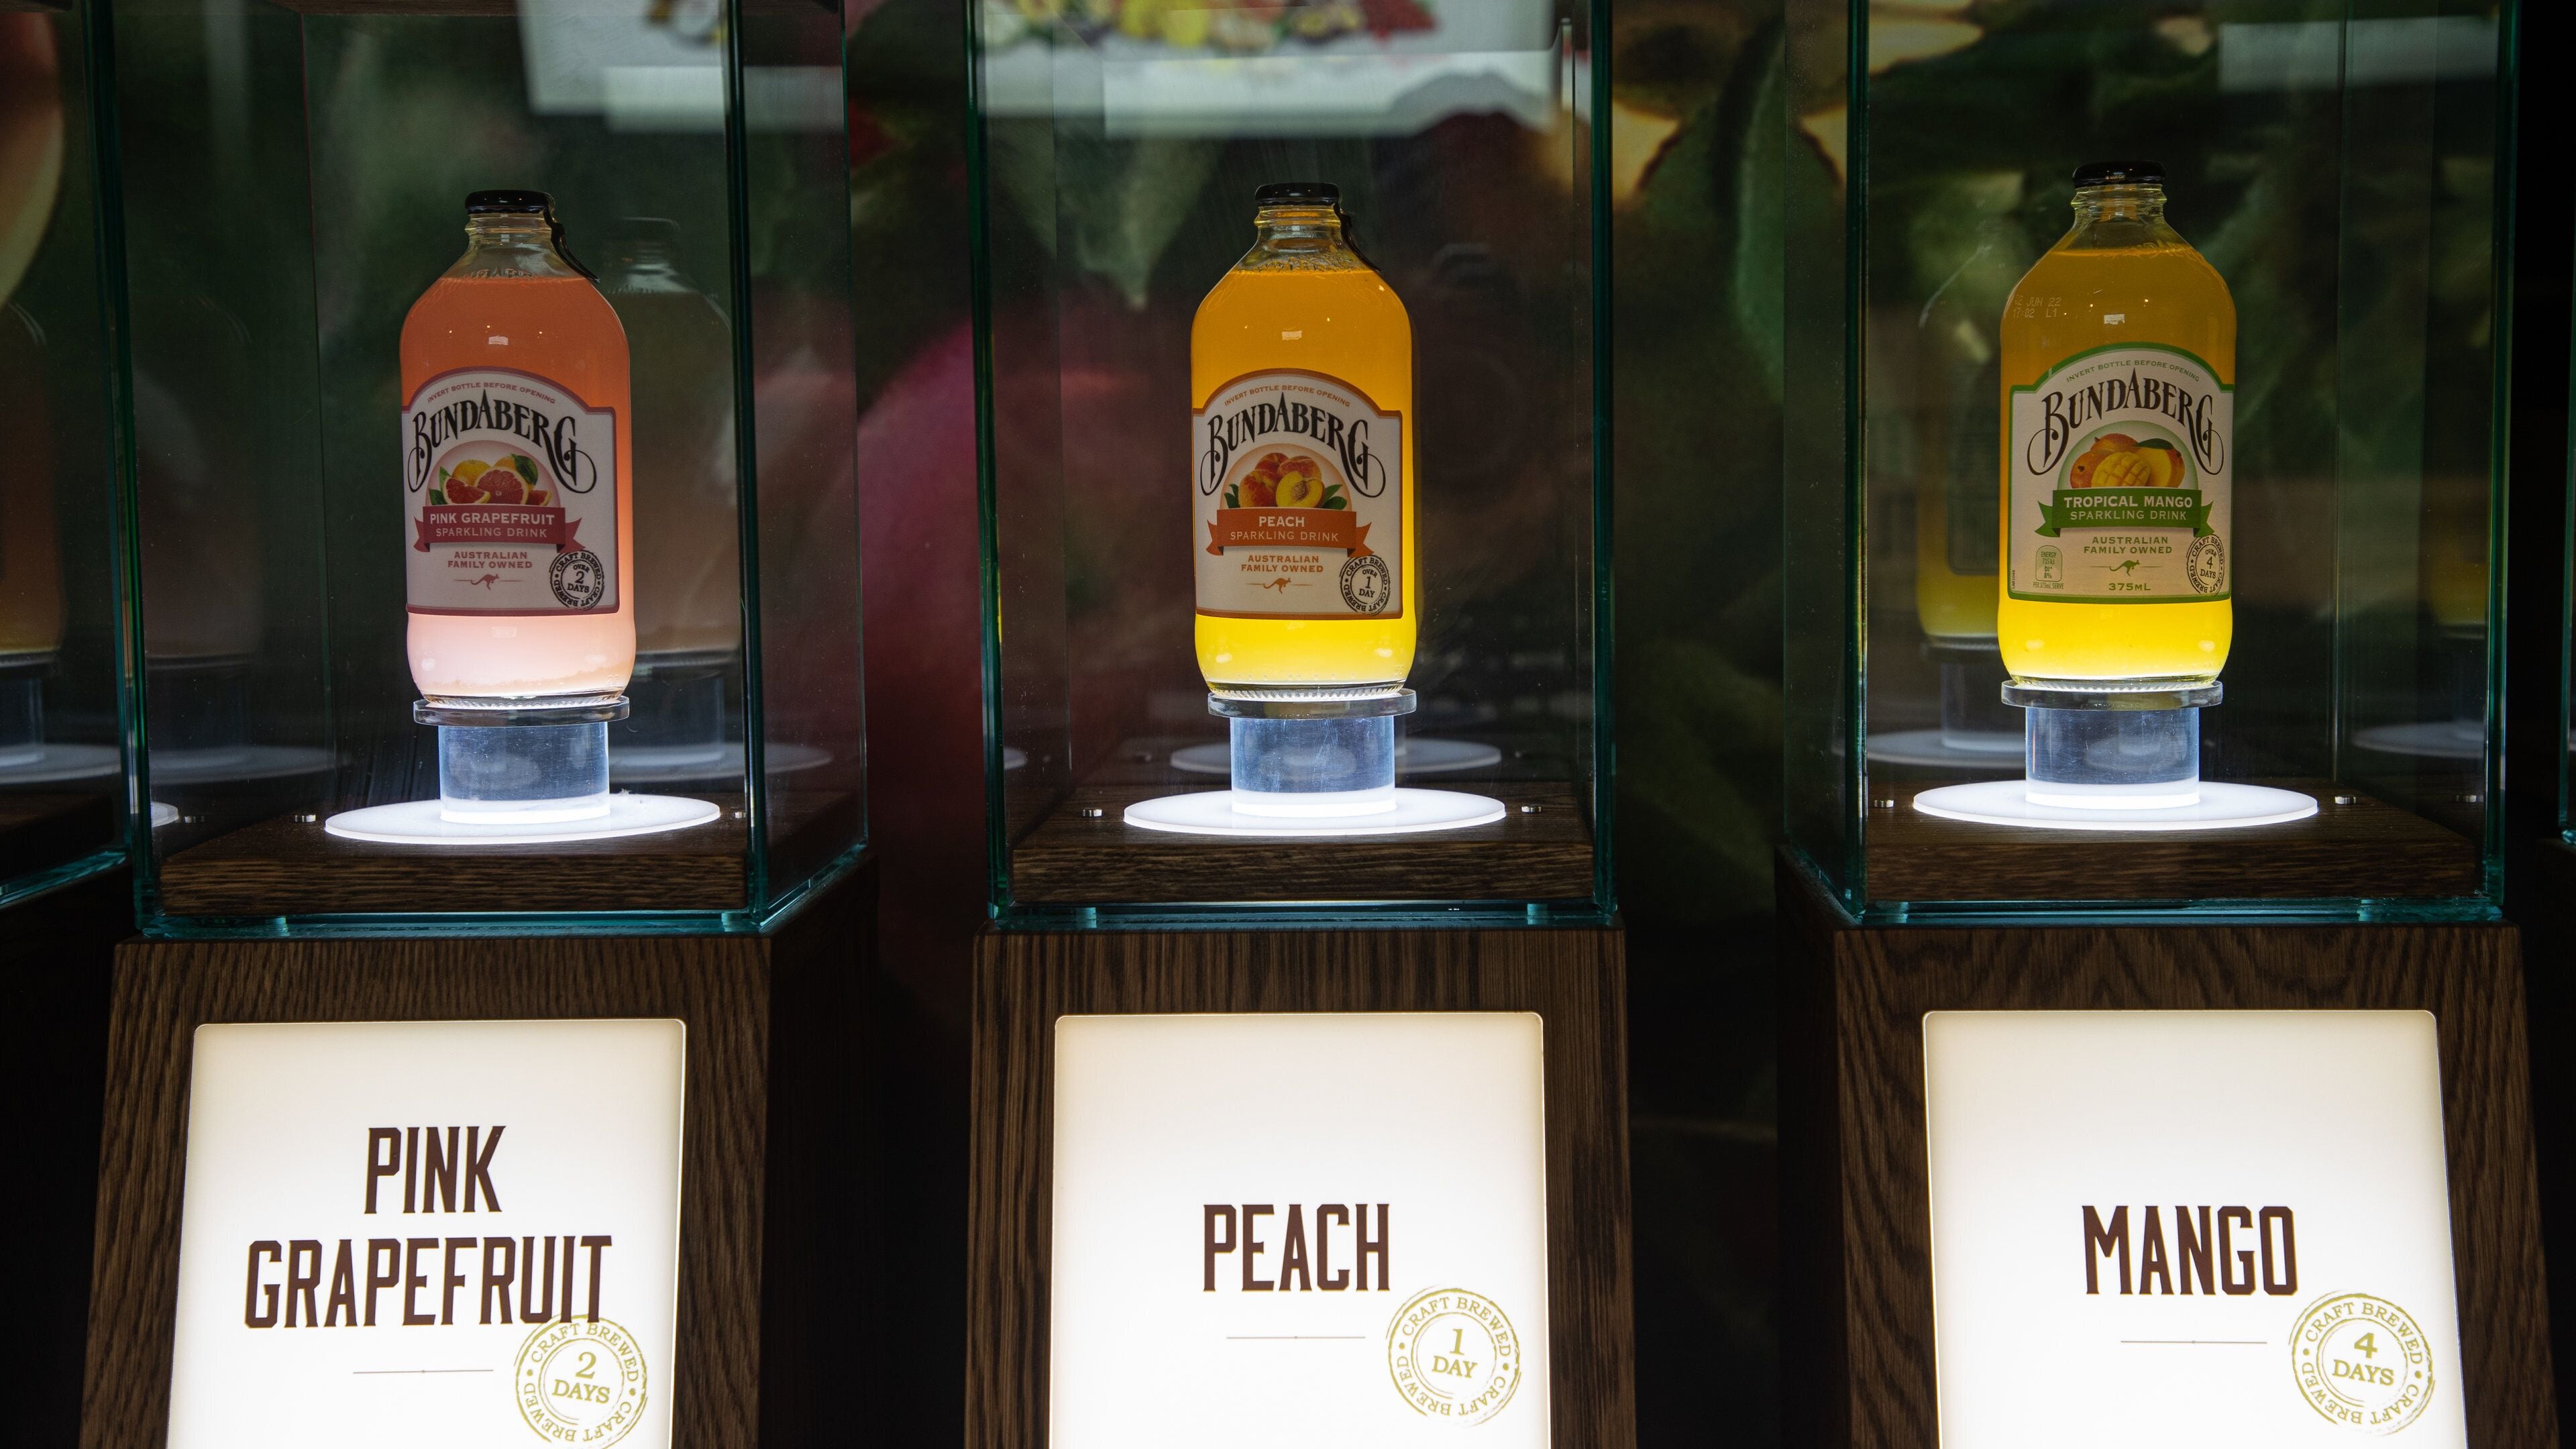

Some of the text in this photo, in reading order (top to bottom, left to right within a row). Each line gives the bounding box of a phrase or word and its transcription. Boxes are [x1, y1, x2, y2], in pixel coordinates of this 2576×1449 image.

[2026, 296, 2044, 307] JUN
[2048, 297, 2062, 307] 22
[2066, 360, 2200, 382] INVERT BOTTLE BEFORE OPENING
[427, 382, 556, 404] INVERT BOTTLE BEFORE OPENING
[1224, 385, 1350, 407] INVERT BOTTLE BEFORE OPENING
[2027, 368, 2224, 476] BUNDABERG
[407, 389, 597, 494] BUNDABERG
[1200, 392, 1386, 498] BUNDABERG
[2064, 496, 2193, 508] TROPICAL MANGO
[429, 513, 555, 525] PINK GRAPEFRUIT
[1258, 516, 1305, 527] PEACH
[2070, 511, 2187, 521] SPARKLING DRINK
[436, 527, 547, 538] SPARKLING DRINK
[1230, 531, 1339, 542] SPARKLING DRINK
[2092, 536, 2168, 545] AUSTRALIAN
[453, 551, 527, 559] AUSTRALIAN
[2084, 545, 2172, 554] FAMILY OWNED
[2192, 537, 2210, 557] CRAFT
[2205, 548, 2217, 557] OVER
[447, 561, 533, 569] FAMILY OWNED
[556, 553, 601, 579] CRAFT BREWED
[573, 564, 590, 573] OVER
[1241, 564, 1324, 573] FAMILY OWNED
[1248, 555, 1320, 564] AUSTRALIAN
[2206, 556, 2213, 569] 4
[575, 571, 584, 584] 2
[1346, 557, 1388, 585] CRAFT BREWED
[1362, 569, 1378, 578] OVER
[2190, 566, 2208, 593] BREWED
[2200, 569, 2216, 579] DAYS
[554, 580, 600, 606] CRAFT BREWED
[567, 583, 589, 593] DAYS
[1359, 588, 1375, 598] DAY
[1365, 576, 1371, 589] 1
[1344, 584, 1386, 611] CRAFT BREWED
[364, 1126, 506, 1214] PINK
[1203, 1203, 1390, 1292] PEACH
[2082, 1205, 2298, 1296] MANGO
[244, 1235, 612, 1328] GRAPEFRUIT
[1403, 1297, 1512, 1357] CRAFT BREWED
[2306, 1302, 2423, 1364] CRAFT BREWED
[1450, 1328, 1465, 1355] 1
[2354, 1332, 2378, 1358] 4
[531, 1323, 639, 1383] CRAFT BREWED
[575, 1352, 596, 1379] 2
[1432, 1355, 1478, 1379] DAY
[2332, 1359, 2394, 1386] DAYS
[552, 1379, 610, 1404] DAYS
[1397, 1356, 1507, 1417] CRAFT BREWED
[2302, 1362, 2420, 1425] CRAFT BREWED
[524, 1383, 633, 1443] CRAFT BREWED
